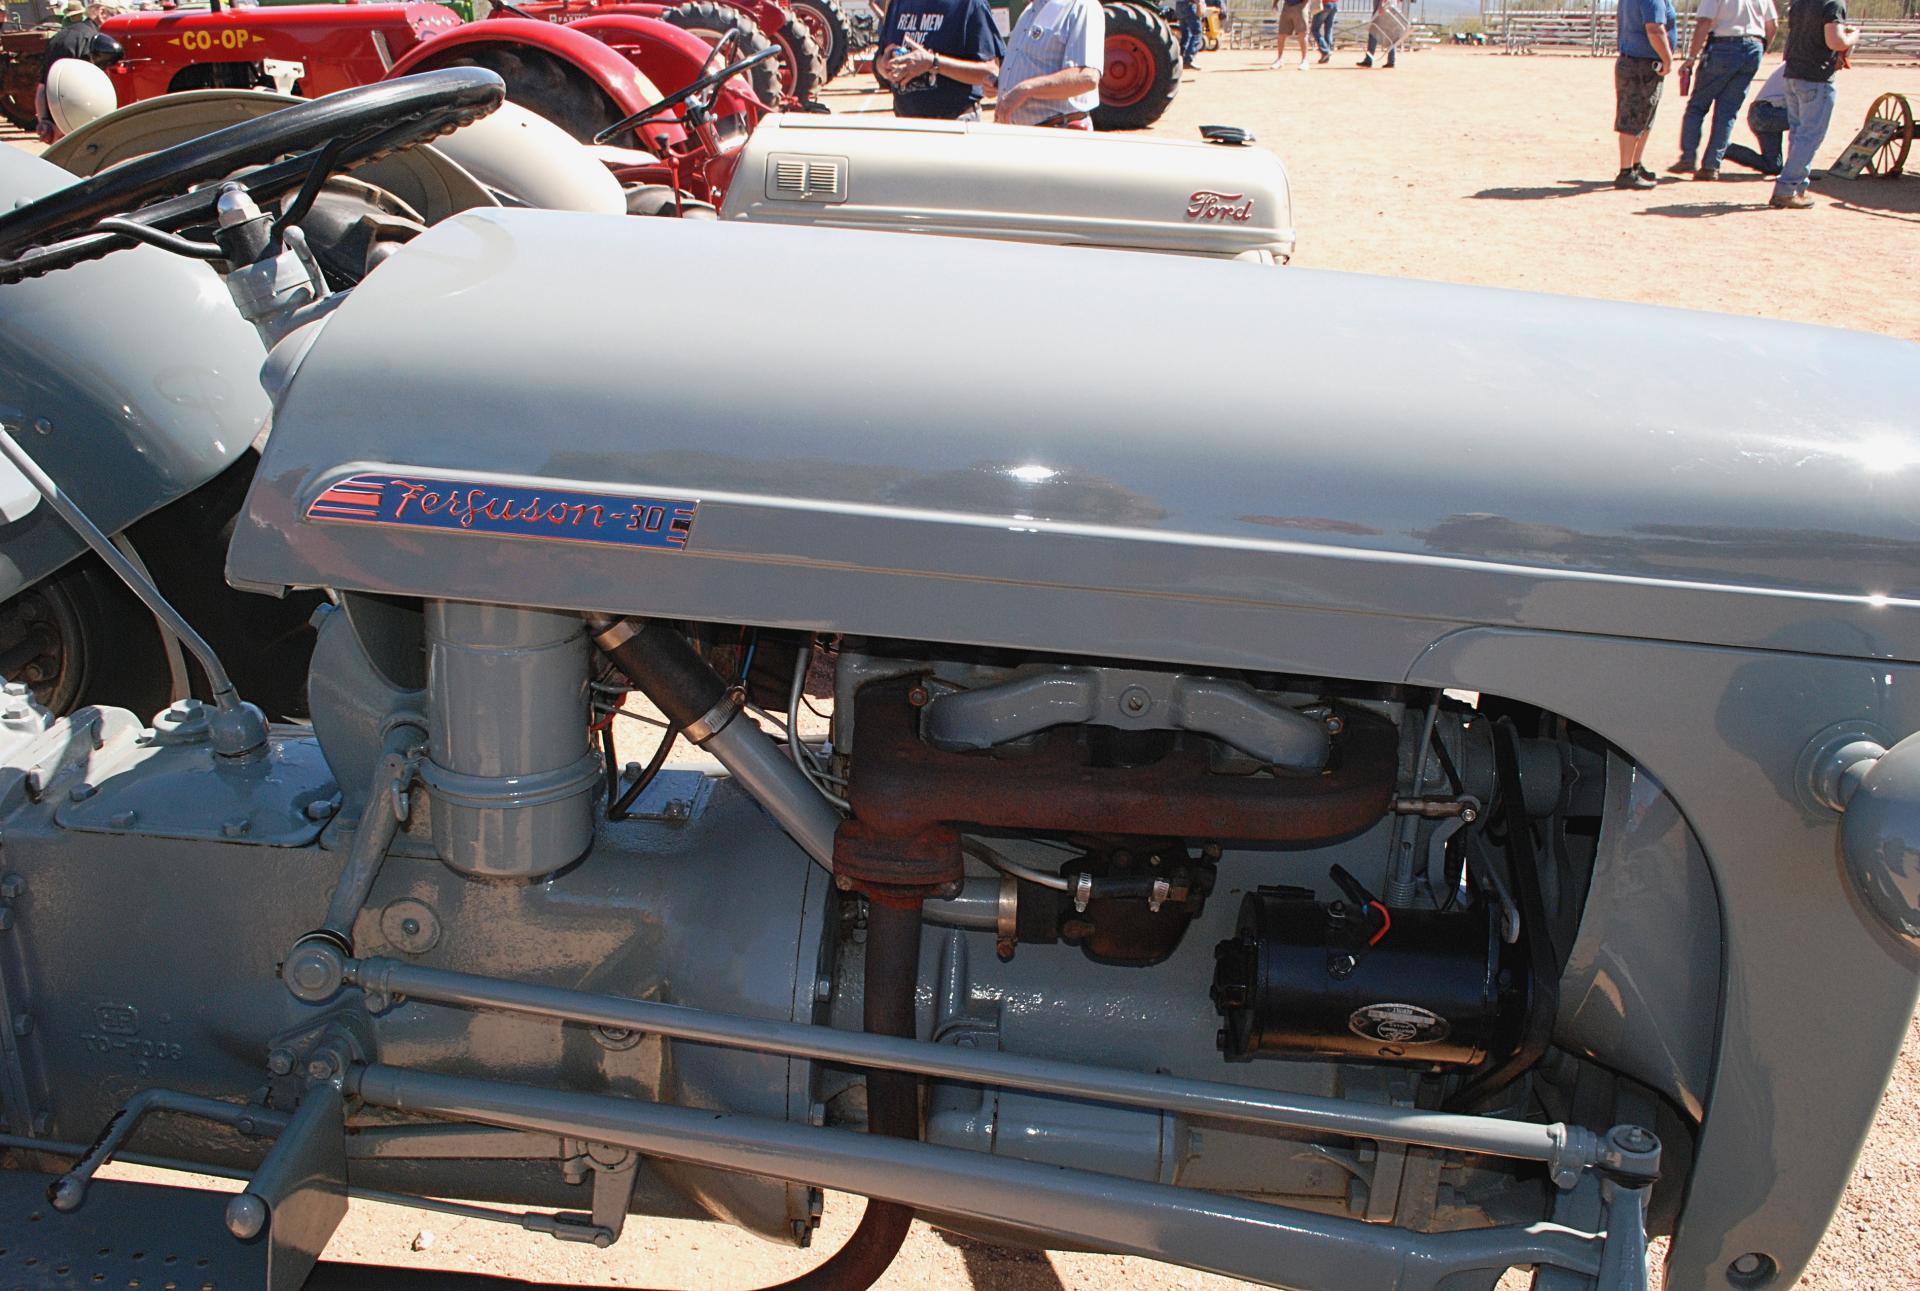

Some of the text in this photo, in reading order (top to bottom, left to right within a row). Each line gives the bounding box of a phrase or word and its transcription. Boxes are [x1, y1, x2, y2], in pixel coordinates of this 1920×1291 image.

[897, 14, 944, 31] REAL MEN
[182, 29, 249, 50] CO-OP
[1186, 190, 1255, 221] Ford
